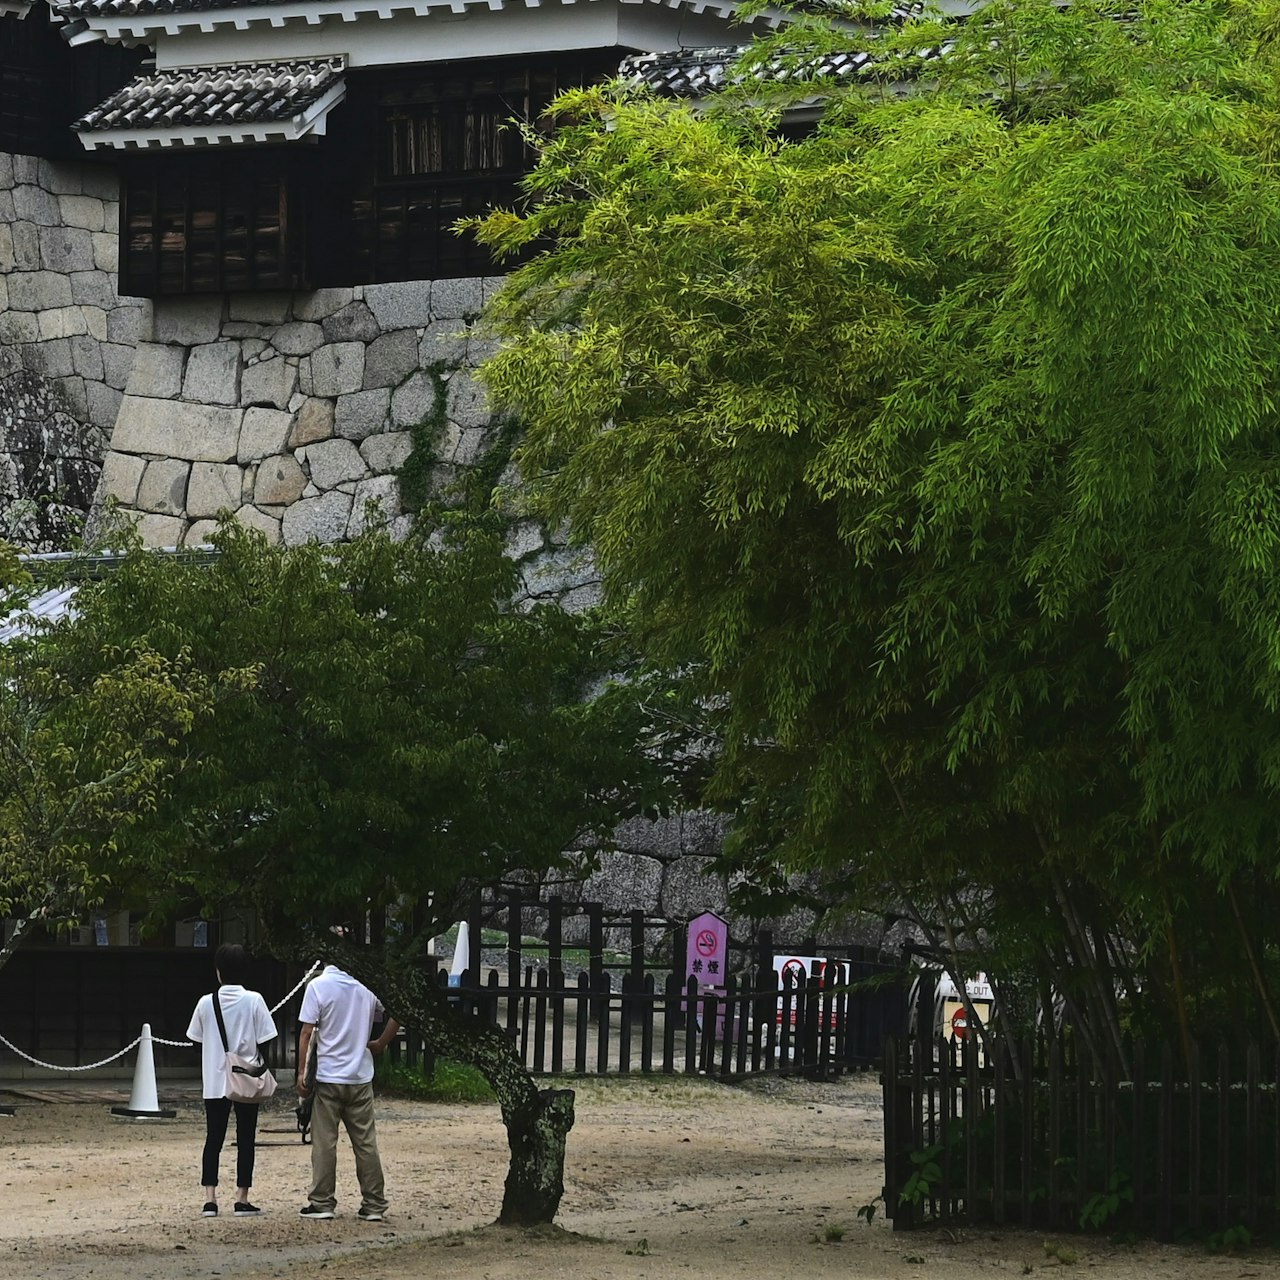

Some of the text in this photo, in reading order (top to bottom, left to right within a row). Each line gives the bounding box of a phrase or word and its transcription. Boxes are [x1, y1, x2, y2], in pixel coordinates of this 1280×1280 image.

[691, 958, 719, 974] 禁煙
[950, 985, 989, 995] KP OUT
